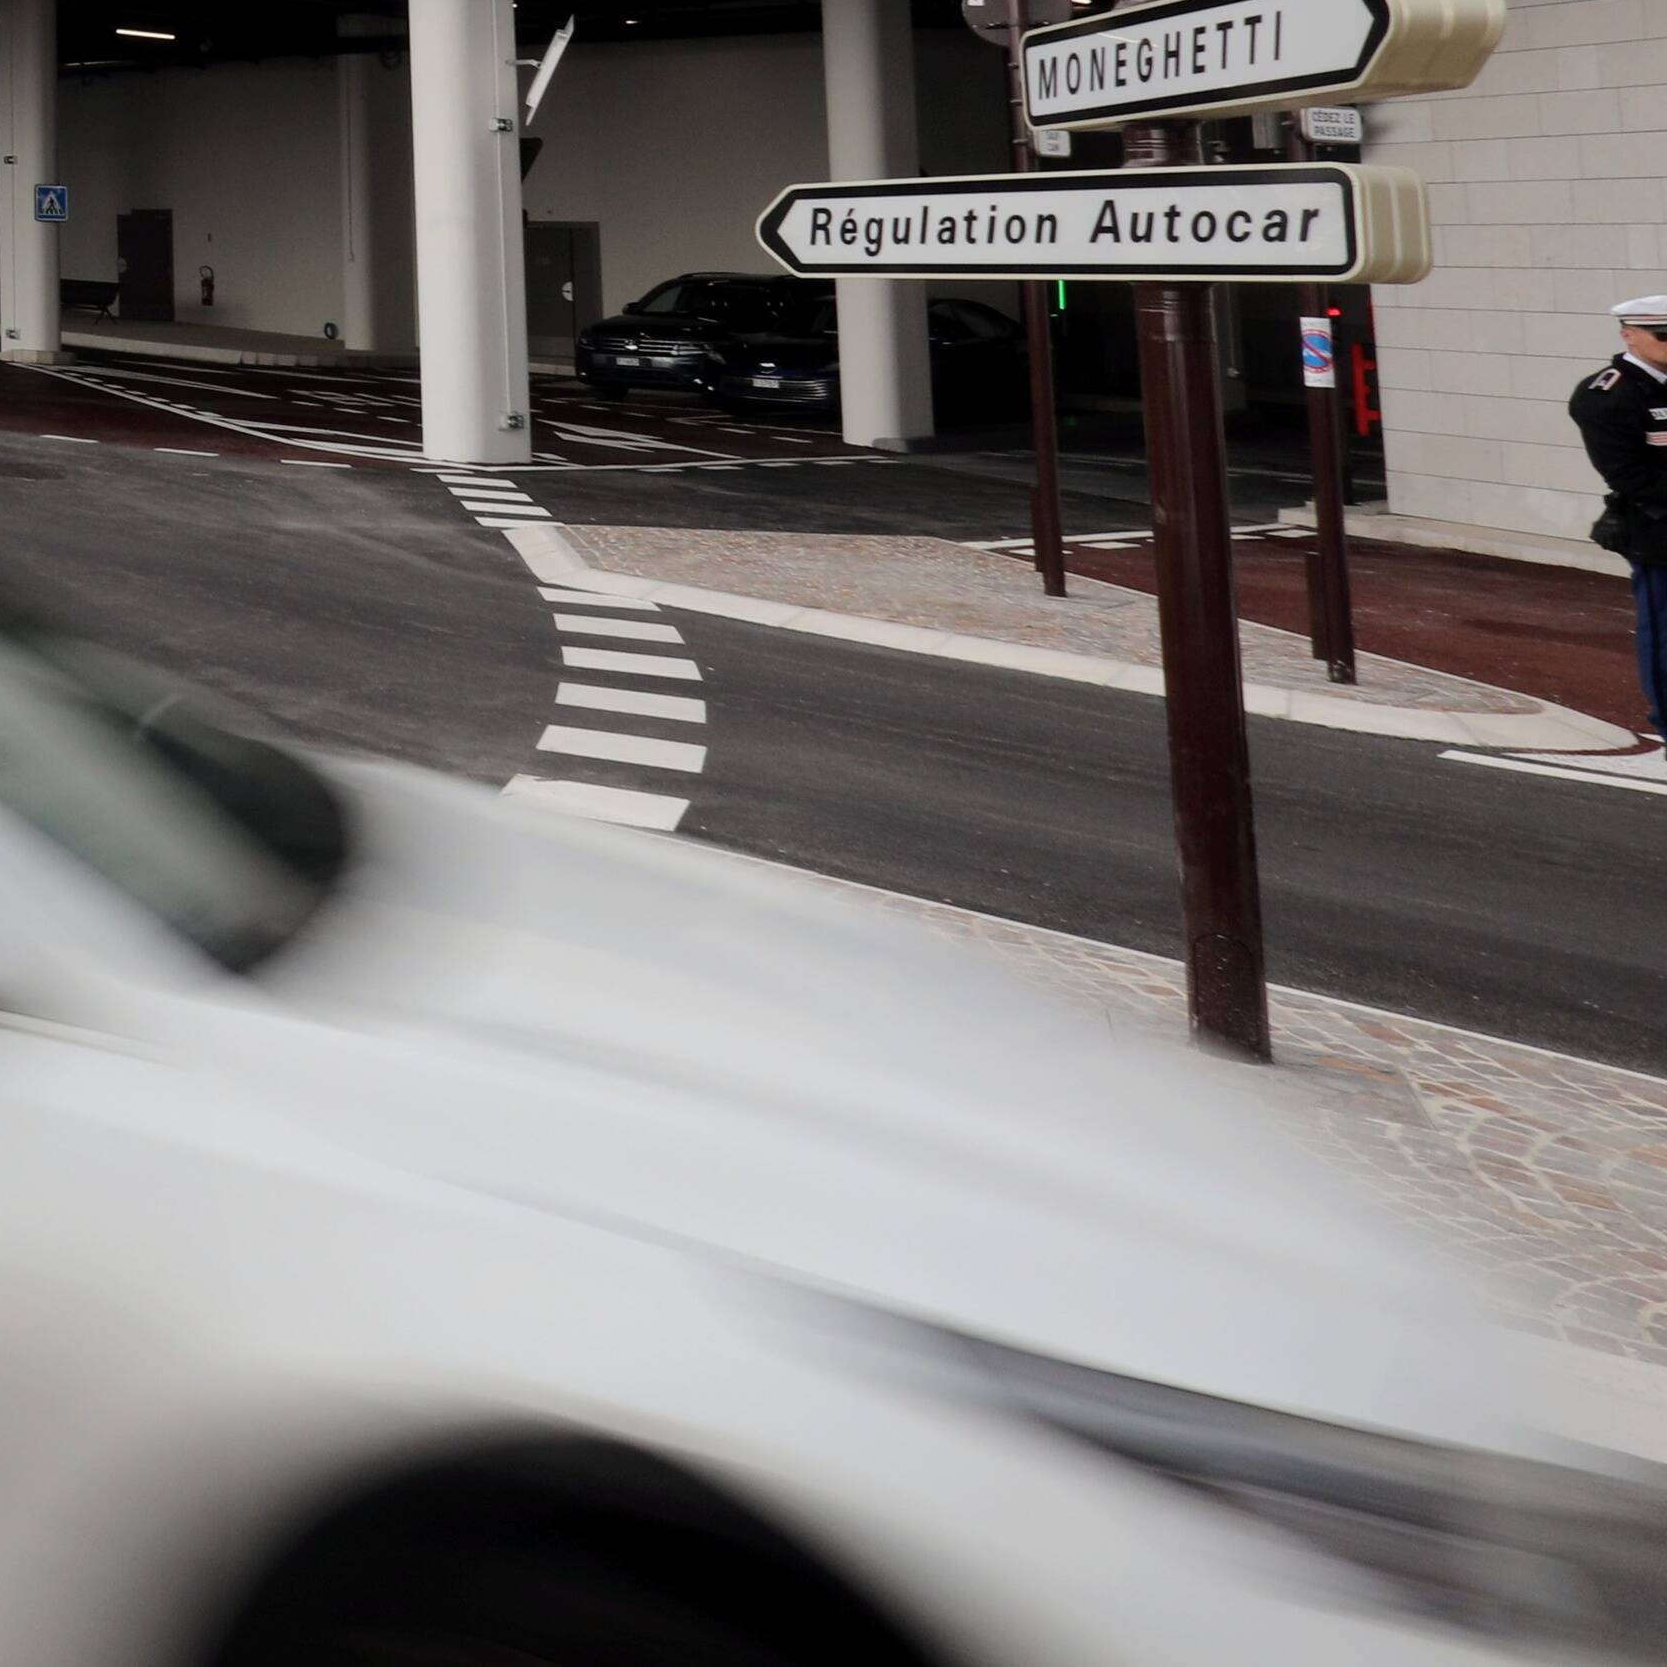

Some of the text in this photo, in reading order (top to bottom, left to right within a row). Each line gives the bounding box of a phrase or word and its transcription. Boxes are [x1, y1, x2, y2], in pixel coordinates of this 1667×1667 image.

[1038, 10, 1282, 101] MONEGHETTI
[809, 199, 1320, 258] Régulation Autocar
